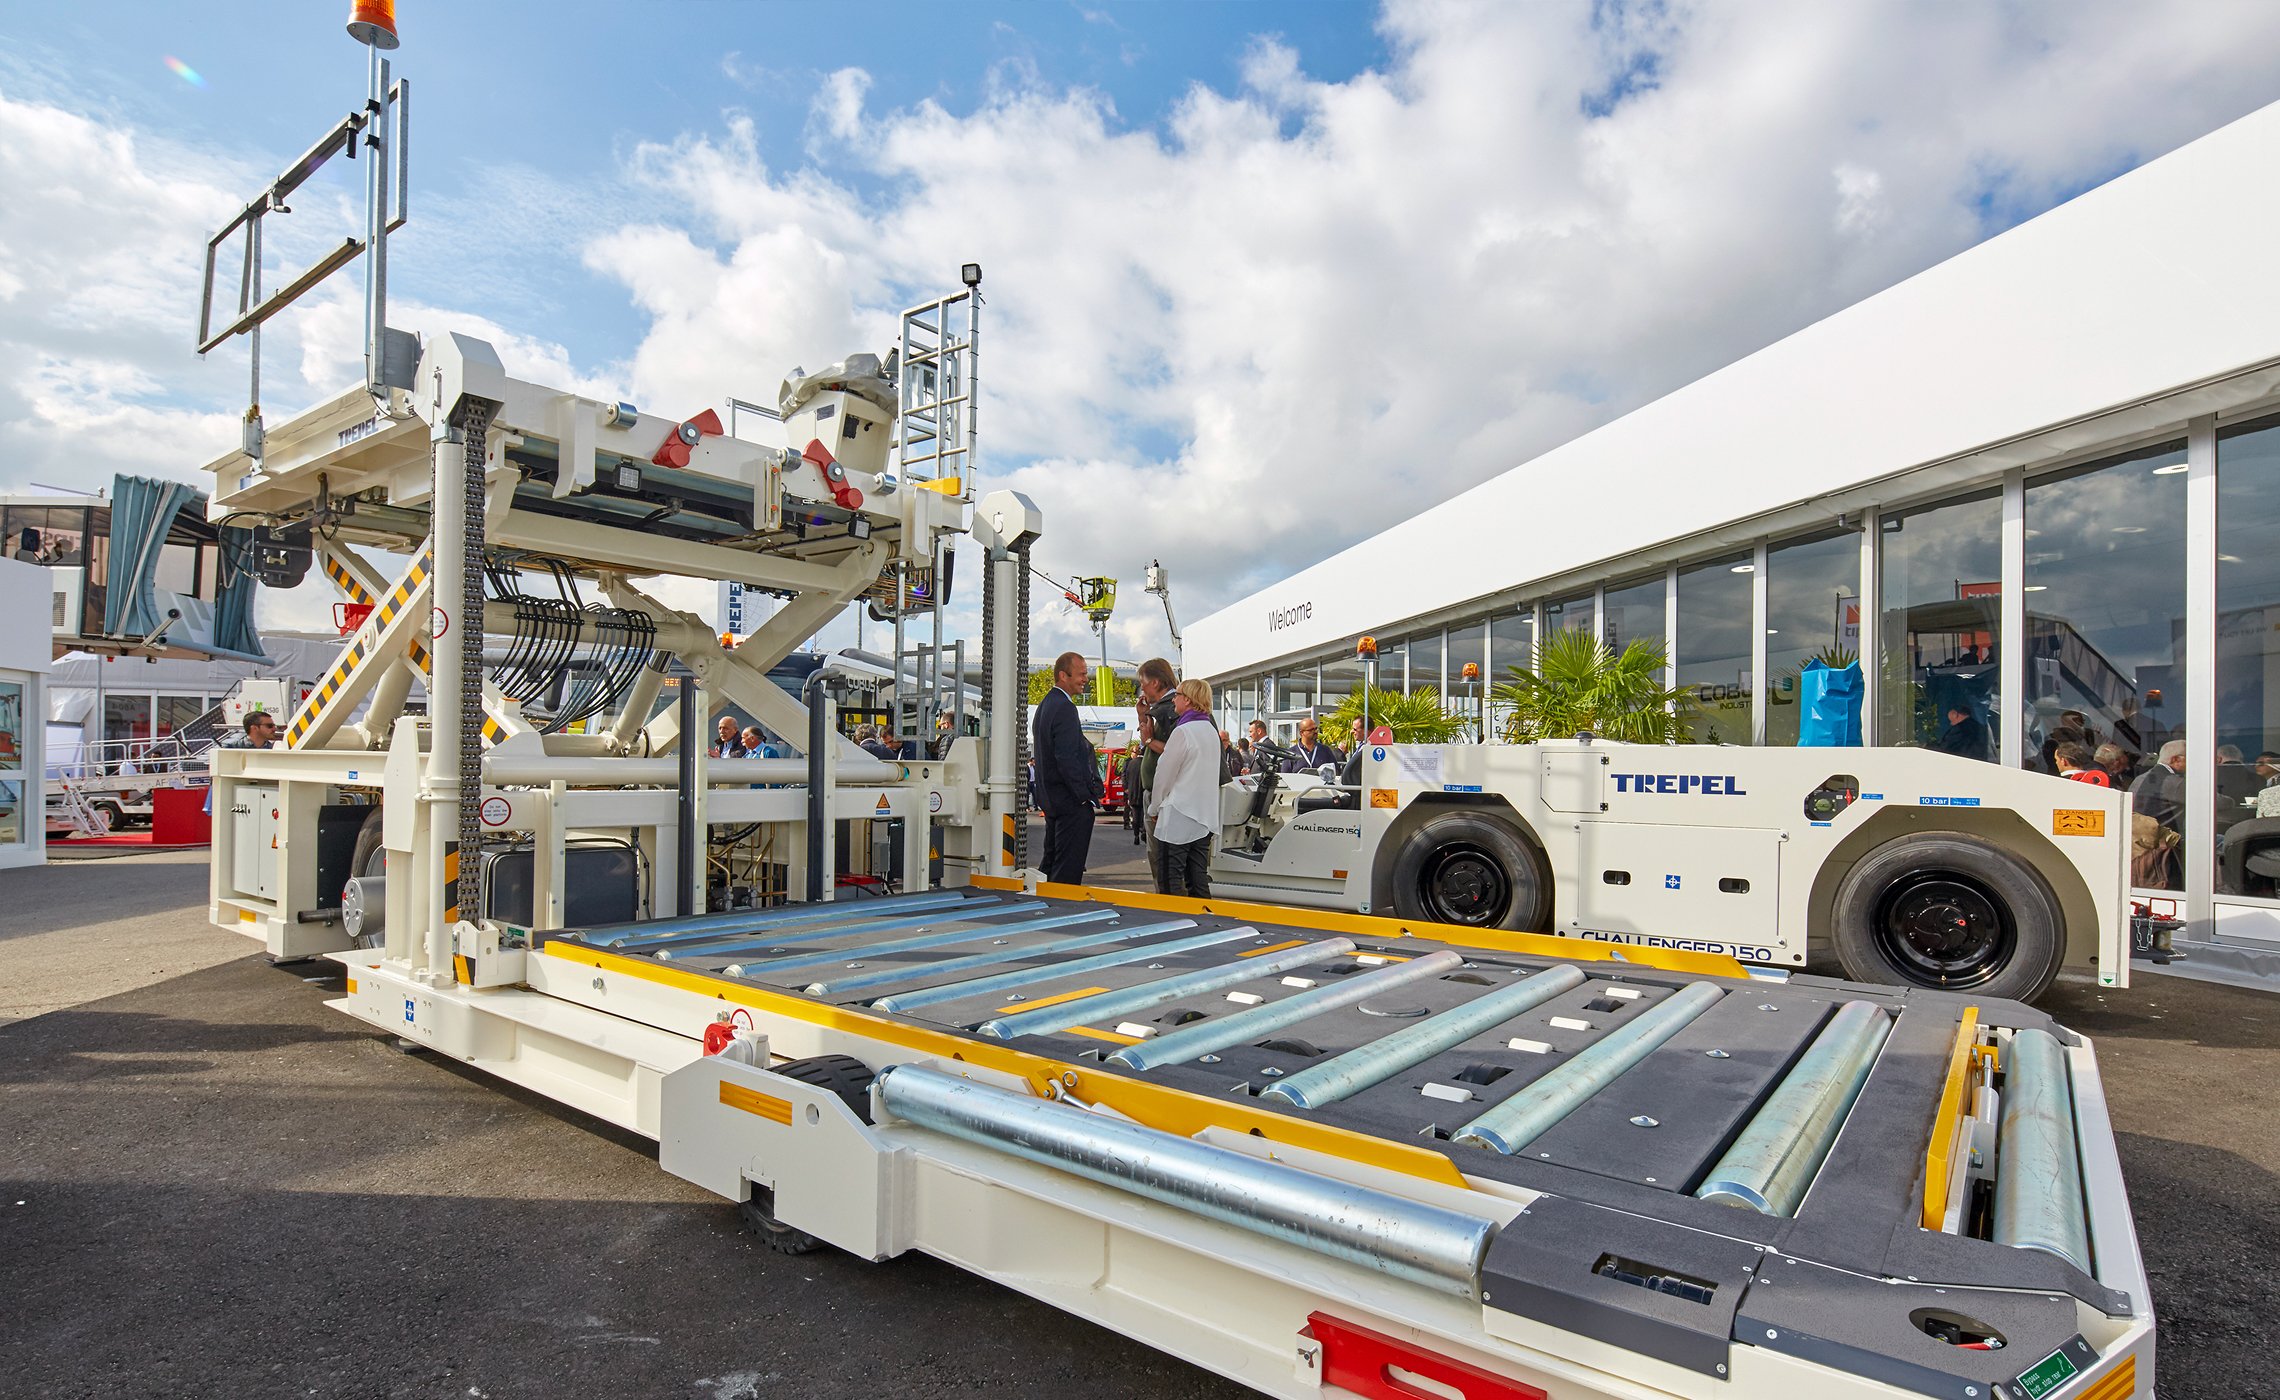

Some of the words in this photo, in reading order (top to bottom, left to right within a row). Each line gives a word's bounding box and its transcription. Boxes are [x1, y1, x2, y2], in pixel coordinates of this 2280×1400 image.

[729, 581, 742, 634] REPE
[1268, 601, 1312, 633] Welcome
[847, 678, 876, 693] COBUS
[1701, 684, 1770, 702] COBU
[1611, 774, 1747, 796] TREPEL
[1293, 824, 1344, 834] CHALLENGER
[1730, 944, 1772, 961] 150
[2023, 1373, 2040, 1386] Bypass
[2041, 1377, 2053, 1387] stop
[2051, 1370, 2062, 1380] rear
